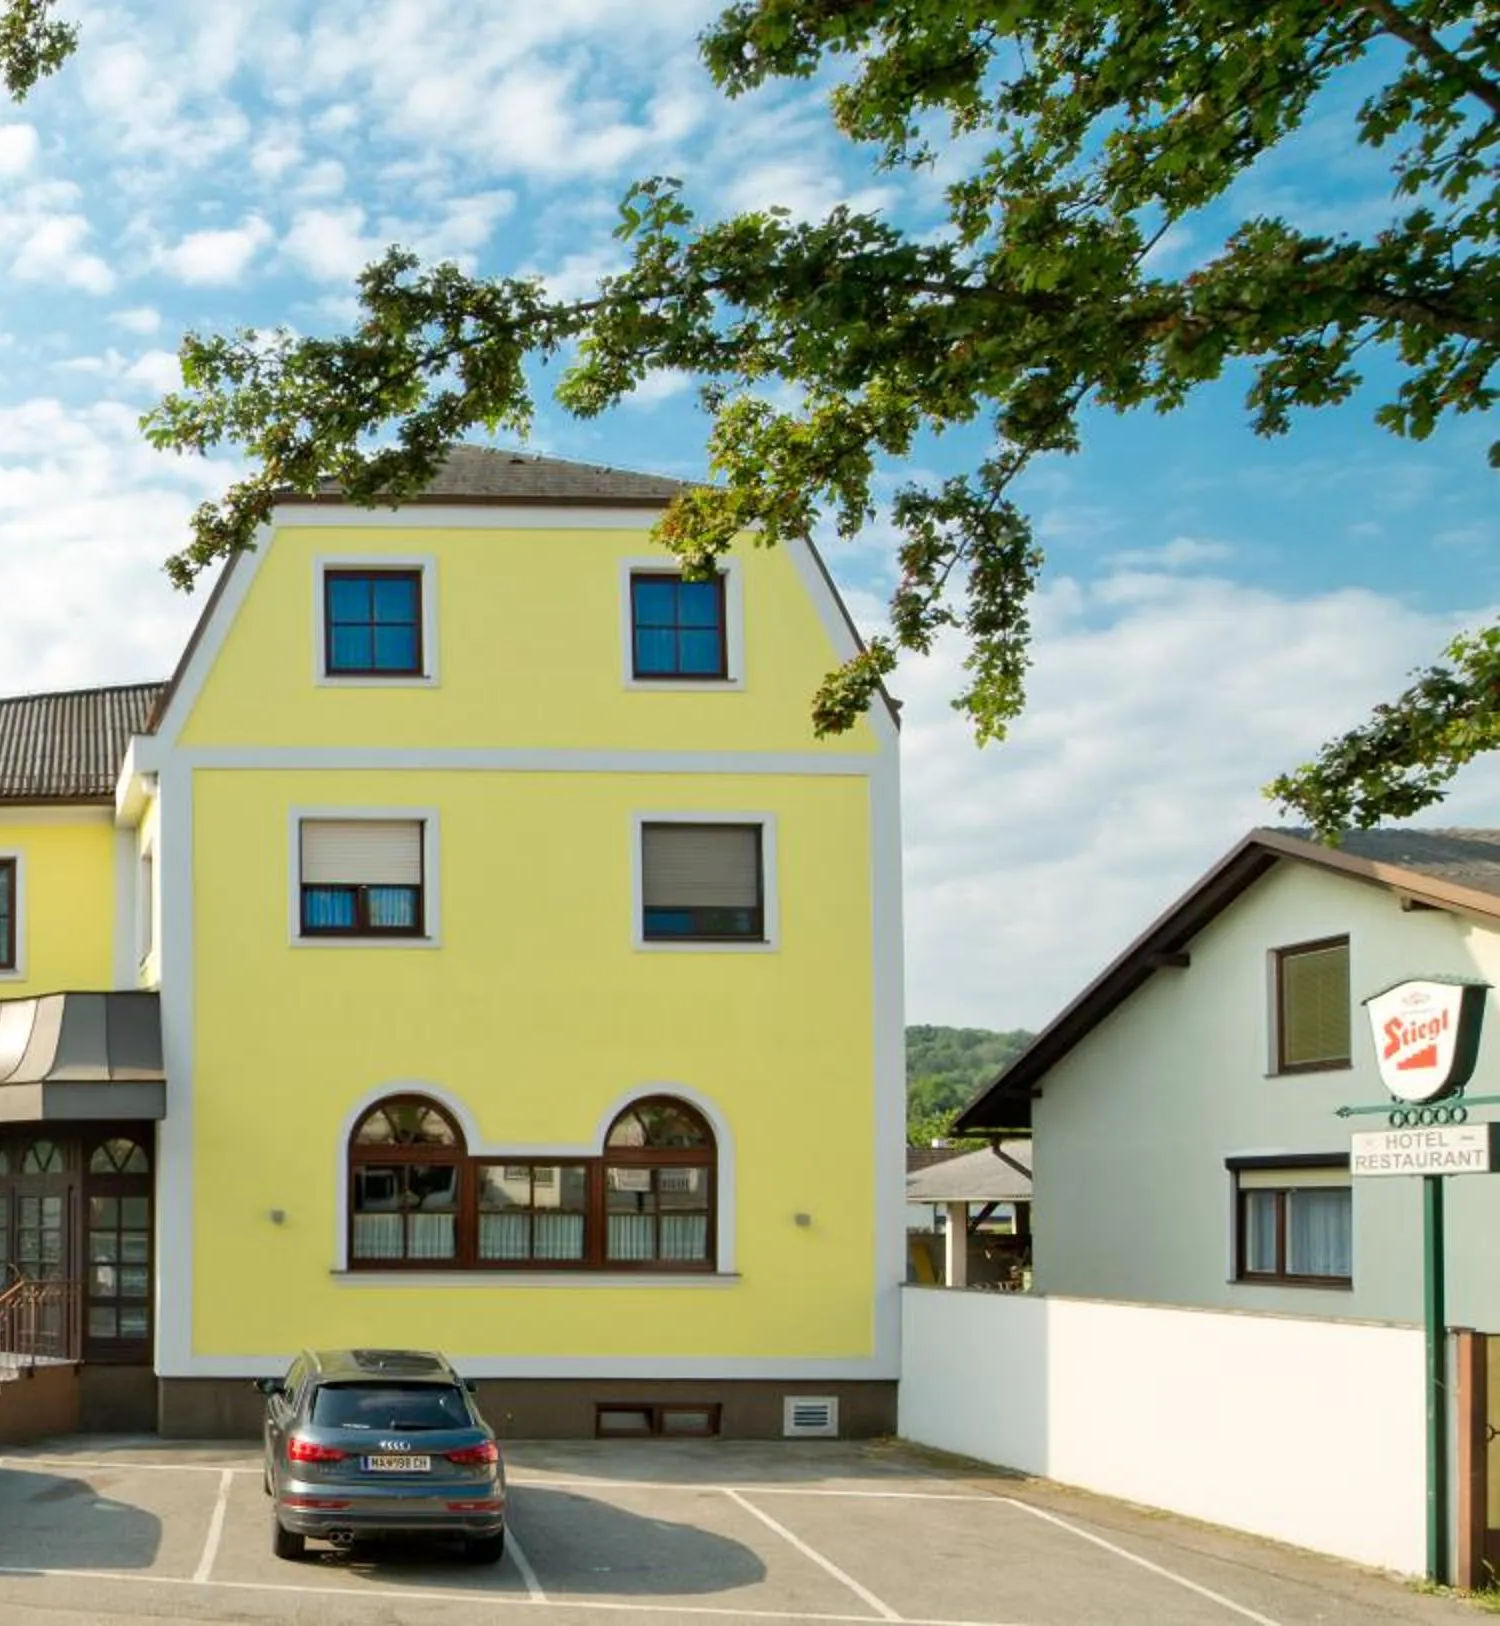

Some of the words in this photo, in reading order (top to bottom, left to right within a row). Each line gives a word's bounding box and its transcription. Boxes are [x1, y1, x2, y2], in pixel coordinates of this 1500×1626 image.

[1383, 1008, 1449, 1059] Stiegl
[1385, 1131, 1450, 1150] HOTEL
[1355, 1149, 1484, 1170] RESTAURANT
